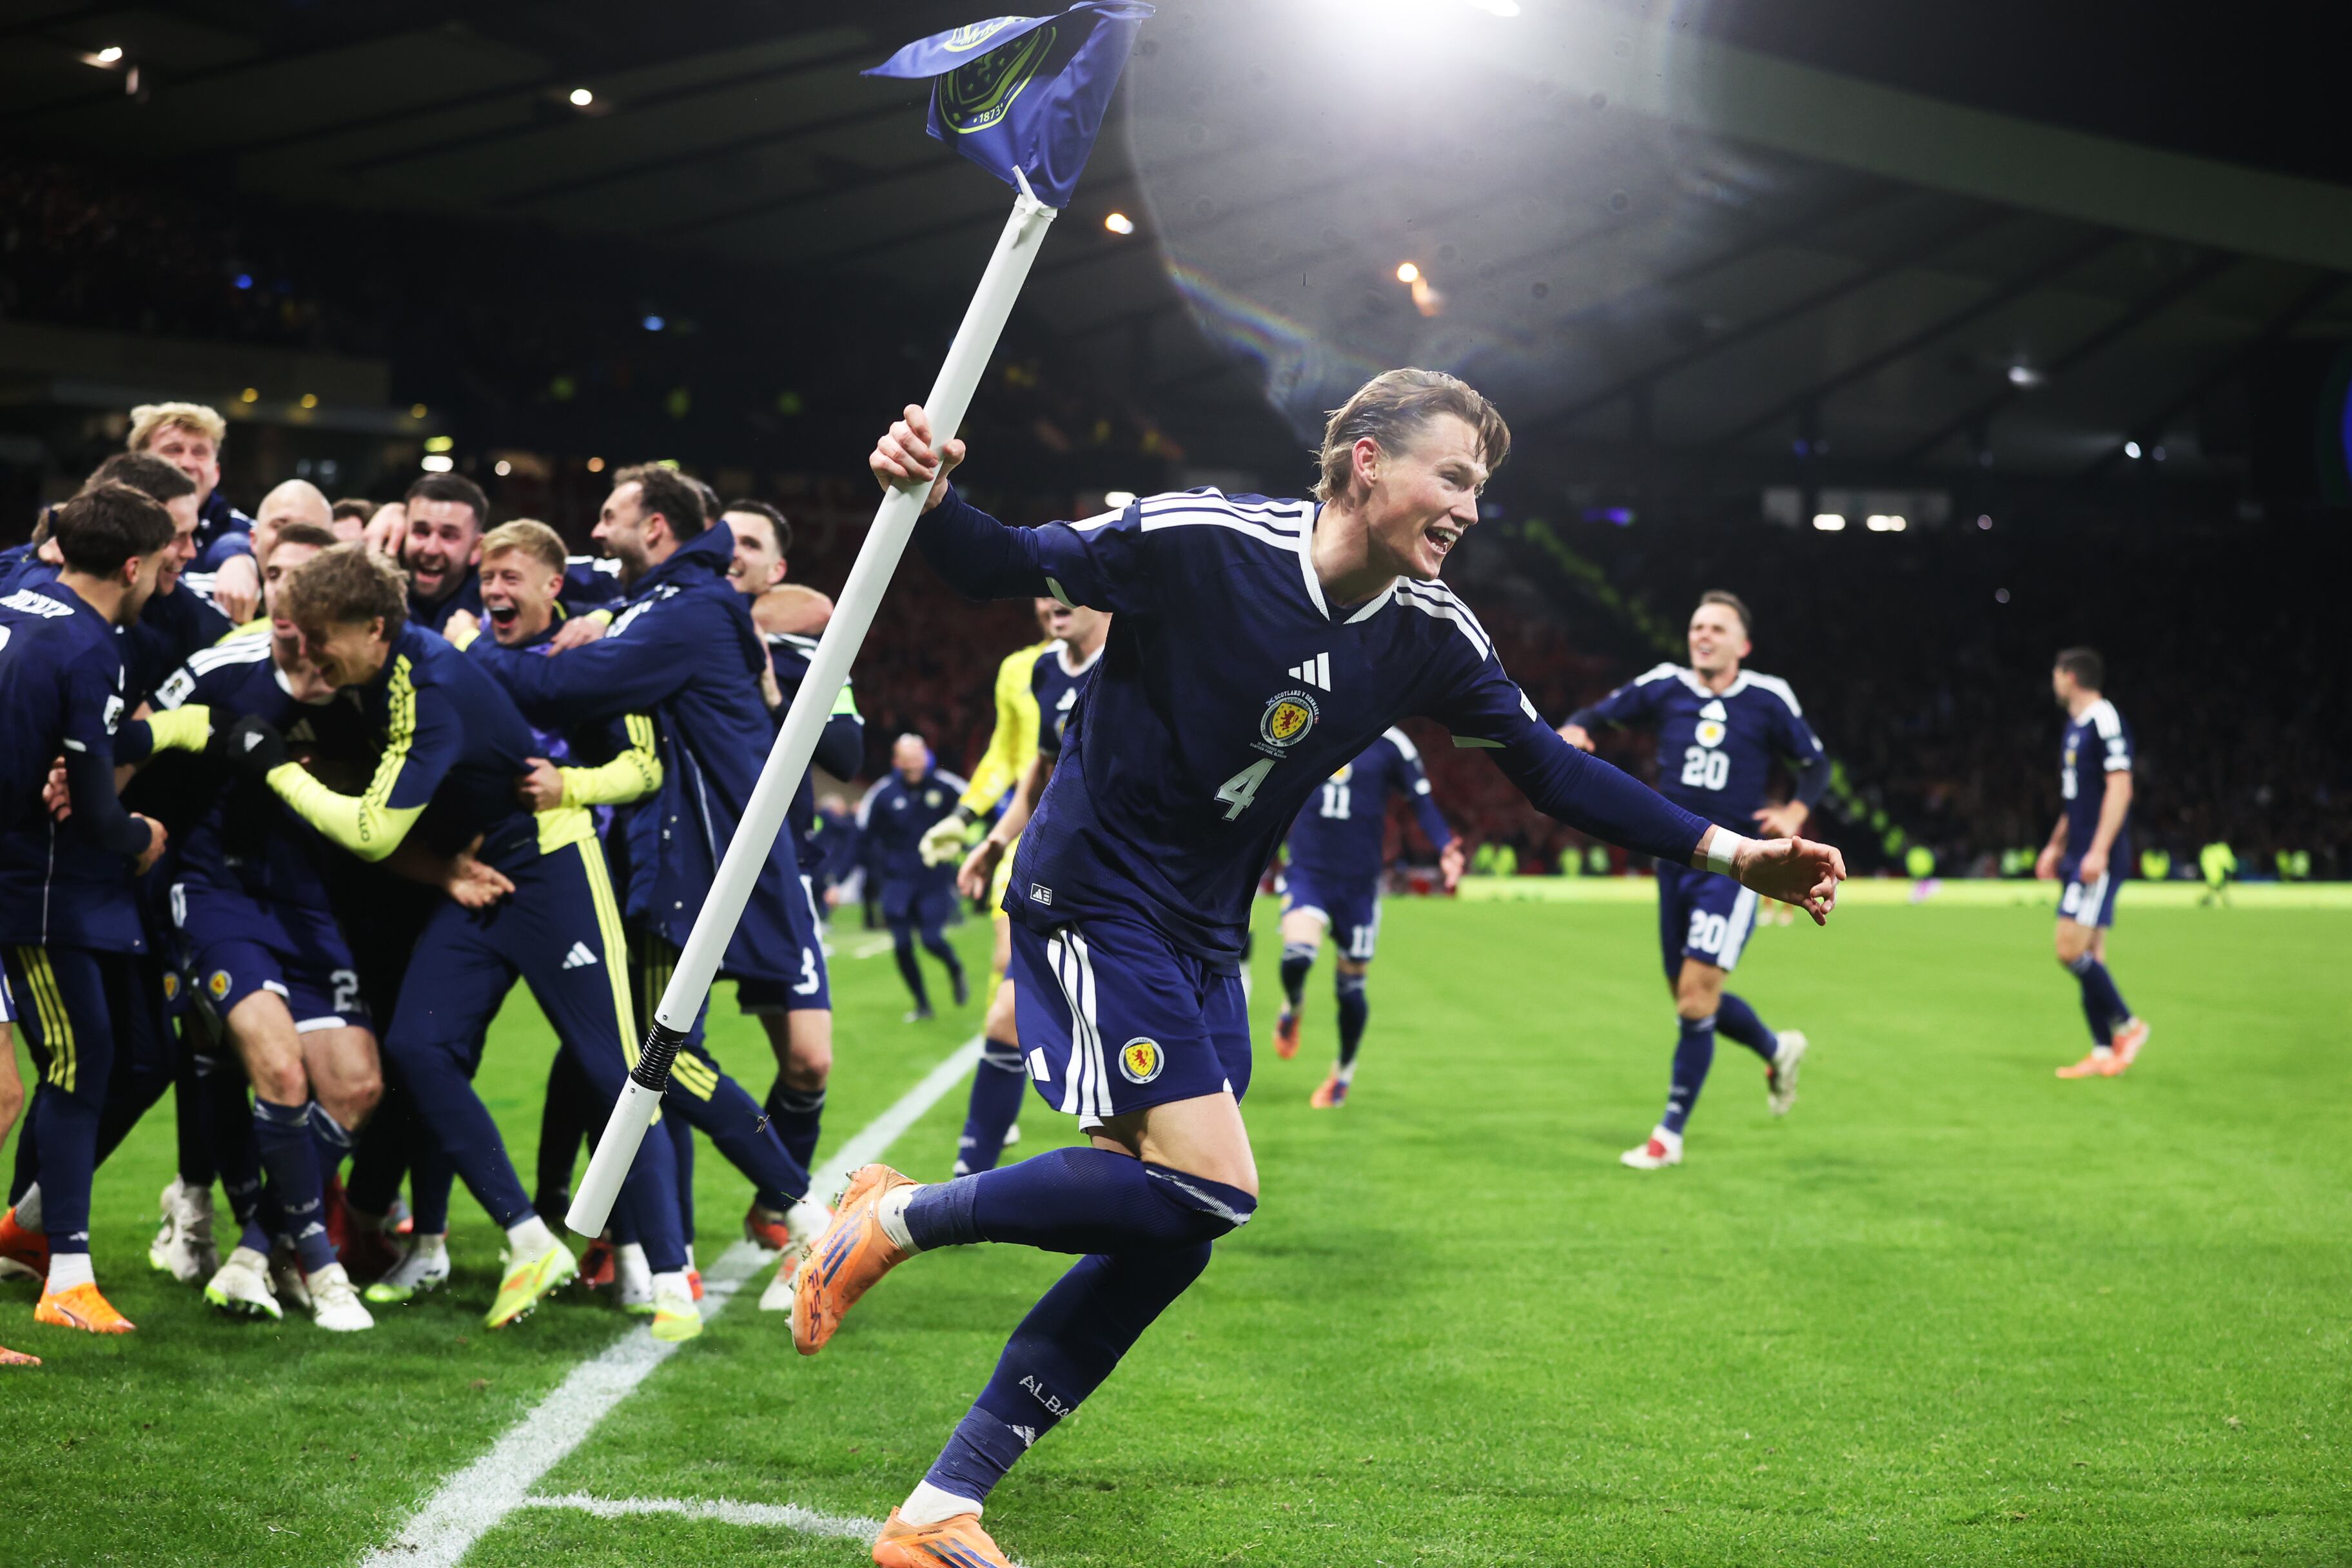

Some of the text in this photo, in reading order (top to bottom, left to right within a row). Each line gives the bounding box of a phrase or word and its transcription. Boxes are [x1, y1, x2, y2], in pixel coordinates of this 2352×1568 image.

[979, 105, 1001, 123] 1873
[1274, 689, 1301, 700] SCOTLAND
[1214, 758, 1276, 821] 4
[1681, 745, 1730, 791] 20
[1320, 783, 1351, 819] 11
[1351, 925, 1374, 957] 11
[1687, 908, 1728, 955] 20
[792, 946, 820, 995] 3
[1019, 1375, 1069, 1420] ALBA
